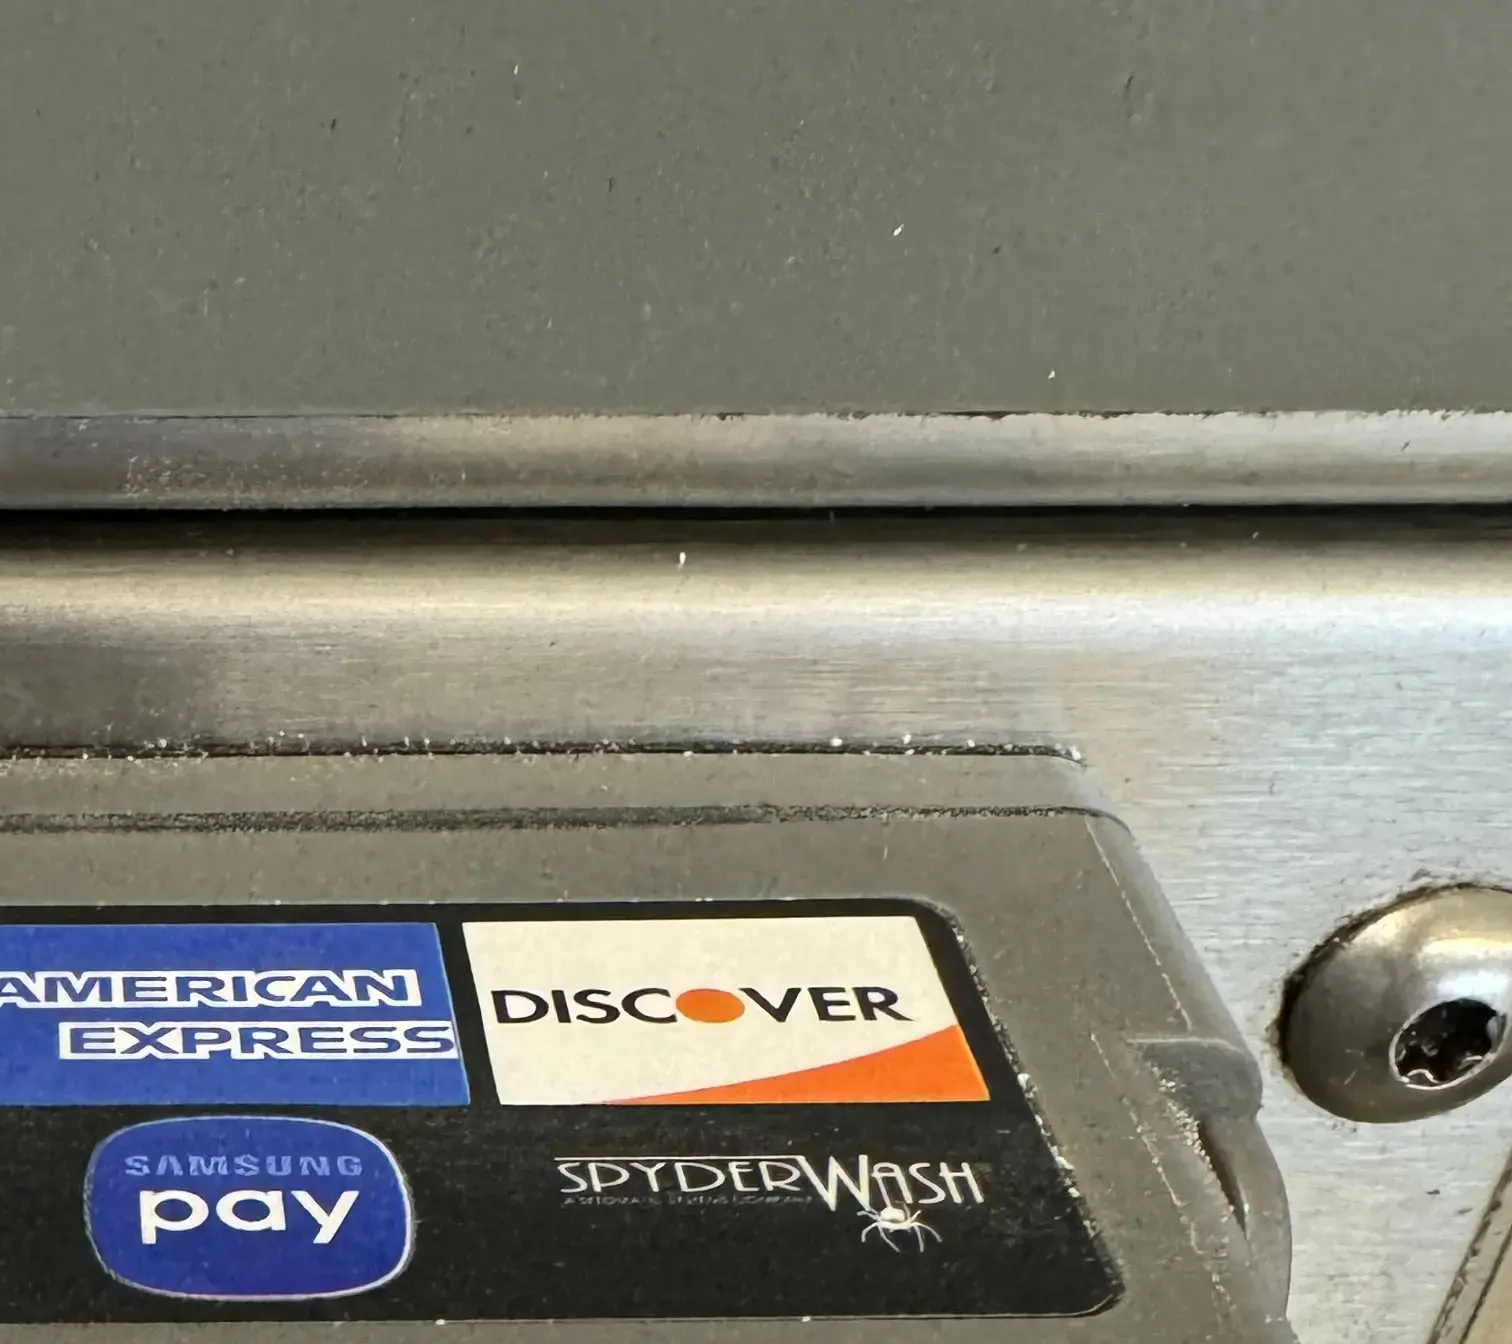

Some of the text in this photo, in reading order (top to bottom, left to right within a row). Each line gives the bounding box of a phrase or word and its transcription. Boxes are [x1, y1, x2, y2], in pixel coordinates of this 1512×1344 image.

[490, 987, 915, 1024] DISCOVER
[65, 1024, 457, 1057] EXPRESS
[125, 1153, 363, 1177] SAMSUNG
[139, 1189, 360, 1245] pay
